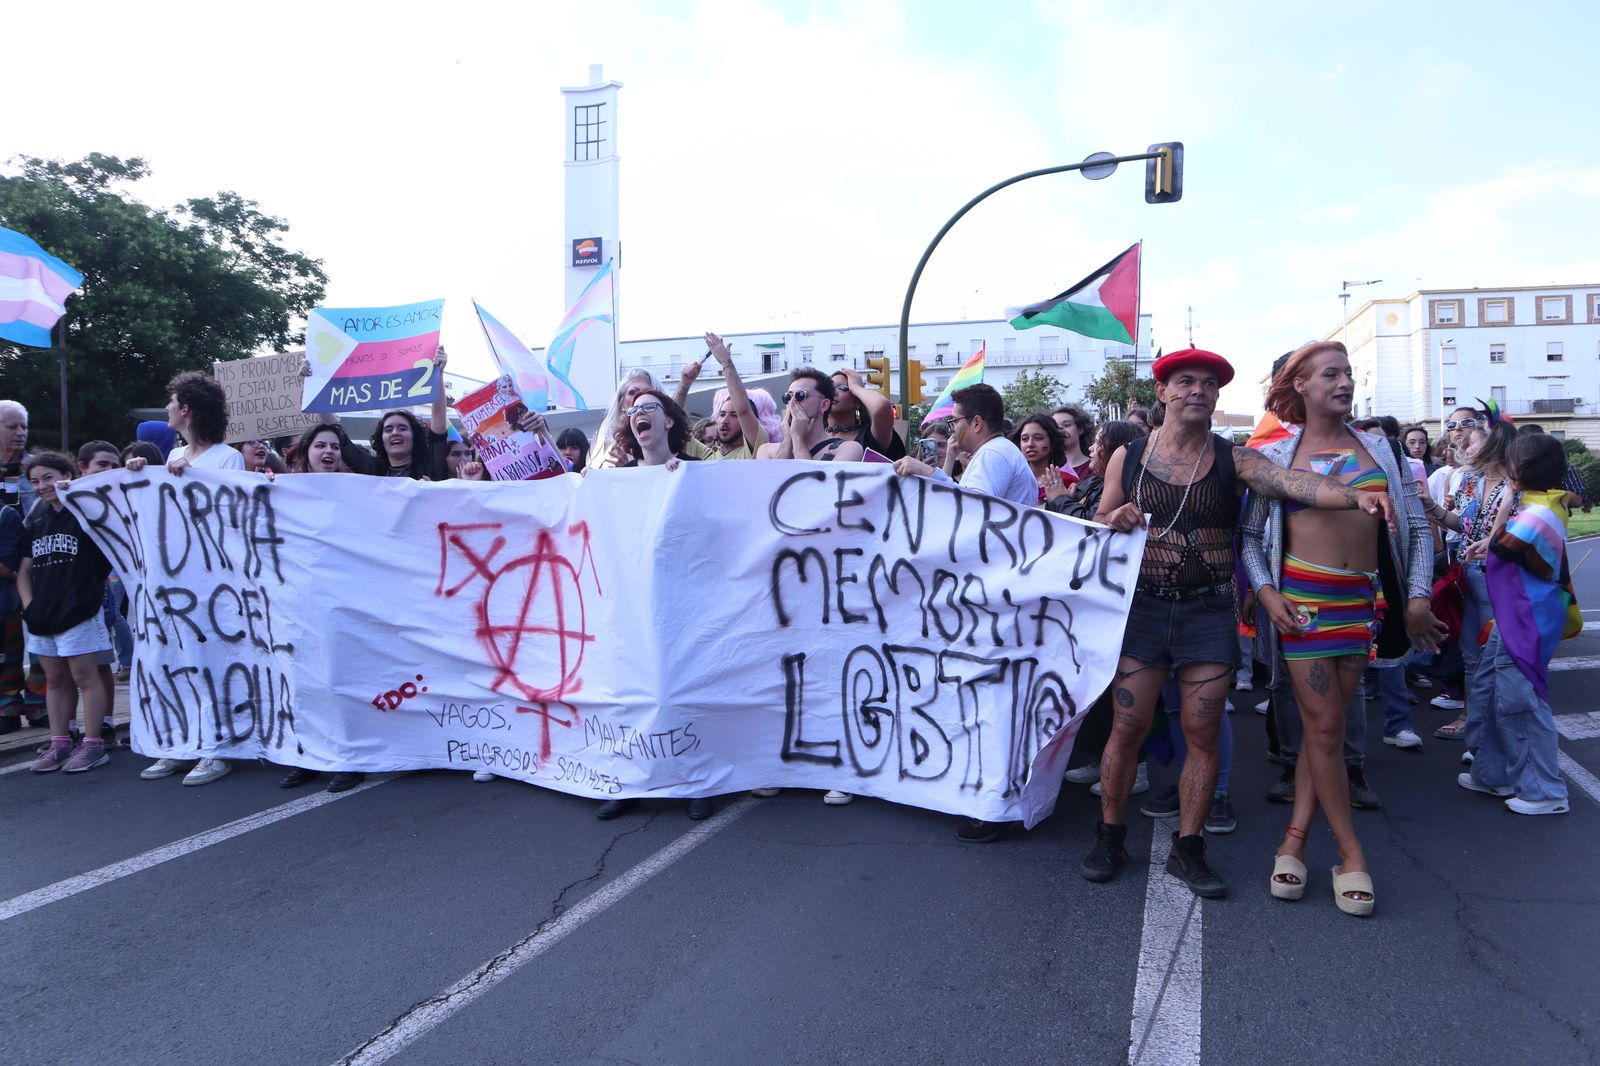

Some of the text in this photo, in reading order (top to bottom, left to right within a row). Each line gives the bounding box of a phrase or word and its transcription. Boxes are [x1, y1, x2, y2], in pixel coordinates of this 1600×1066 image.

[385, 313, 402, 329] ES
[217, 365, 236, 381] MIS
[330, 357, 434, 405] MAS DE 2
[225, 421, 246, 436] ARA
[768, 470, 1129, 597] CENTRO DE
[133, 582, 295, 655] CARCEL
[770, 546, 1081, 674] MEMORIA
[136, 657, 304, 756] ANTIGUA
[425, 703, 701, 761] VAGOS, MALEANTES,
[447, 739, 623, 795] PELIGROSOS SOCIALES
